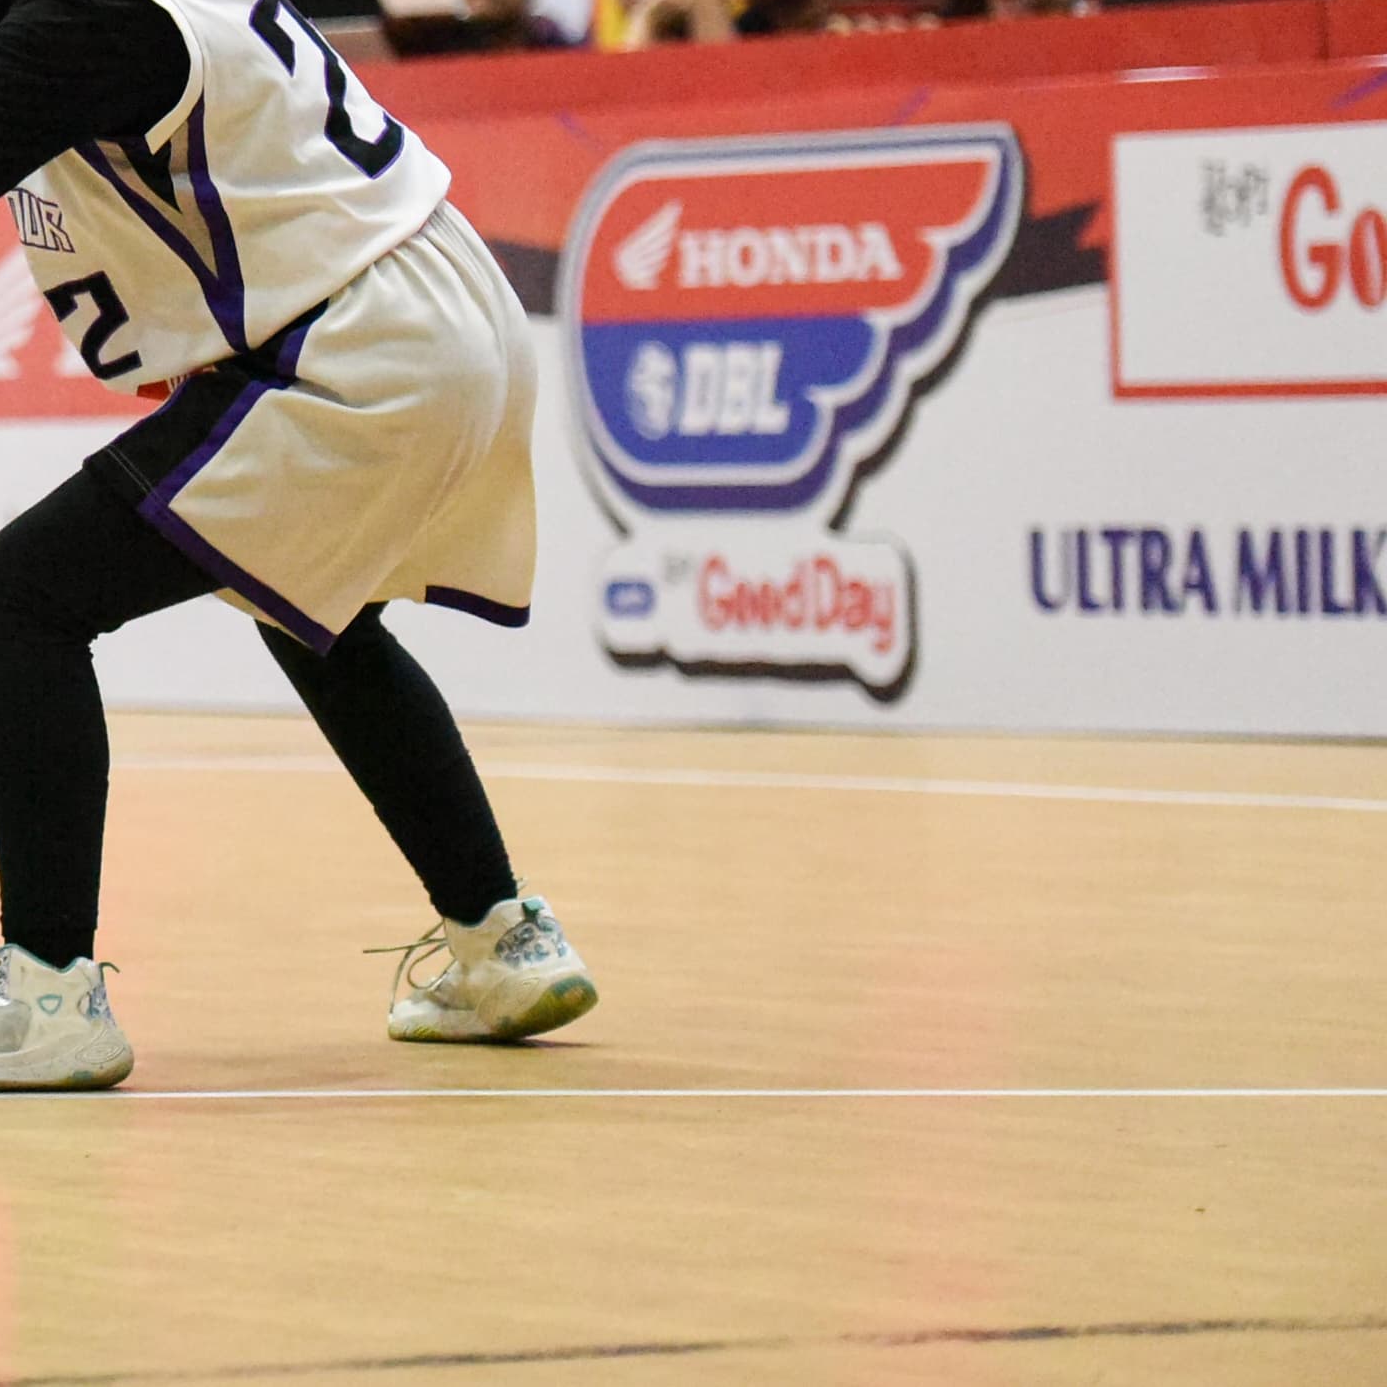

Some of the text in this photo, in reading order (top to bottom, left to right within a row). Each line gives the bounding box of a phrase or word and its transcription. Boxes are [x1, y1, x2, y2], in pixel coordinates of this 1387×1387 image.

[679, 221, 903, 288] HONDA
[43, 270, 143, 380] 2
[679, 340, 791, 437] DBL
[1028, 527, 1387, 615] ULTRA MILK
